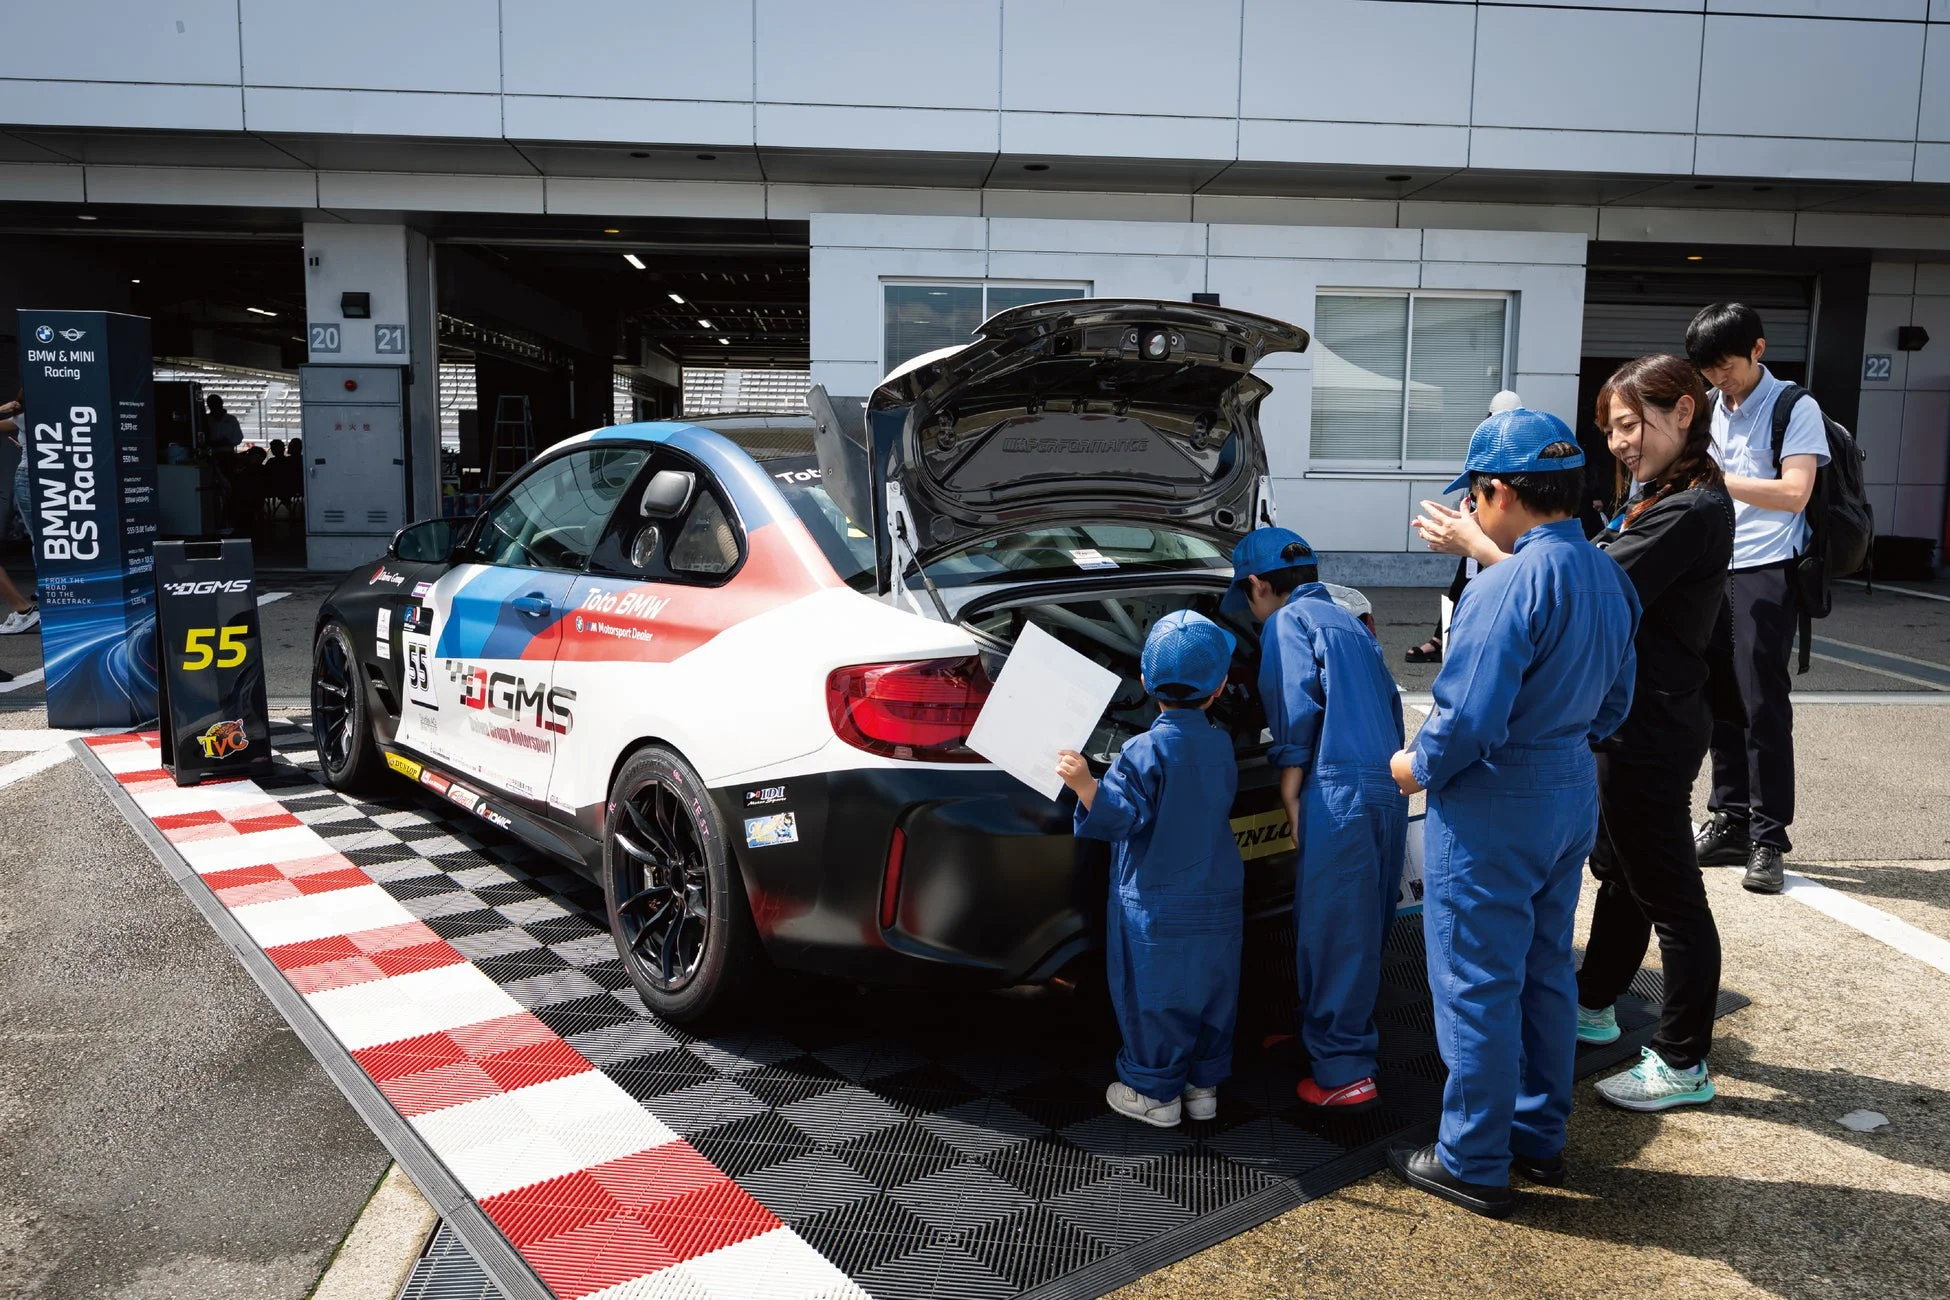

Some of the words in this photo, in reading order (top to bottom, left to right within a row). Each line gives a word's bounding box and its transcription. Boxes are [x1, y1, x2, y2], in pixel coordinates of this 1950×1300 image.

[311, 327, 339, 349] 20
[377, 328, 402, 350] 21
[28, 350, 56, 362] BMW
[58, 350, 68, 362] &
[70, 350, 95, 362] MINI
[1866, 357, 1890, 378] 22
[44, 365, 81, 381] Racing
[34, 422, 65, 469] M2
[1028, 438, 1149, 454] PERFORMANCE
[65, 406, 97, 511] Racing
[38, 477, 71, 560] BMW
[70, 520, 100, 561] CS
[171, 579, 252, 596] DGMS
[581, 587, 618, 614] Toto
[614, 592, 672, 619] BMW
[598, 621, 632, 639] Motorsport
[631, 627, 654, 642] Dealer
[182, 625, 249, 671] 55
[407, 641, 430, 692] 55
[460, 666, 577, 735] DGMS
[197, 730, 249, 759] TVC
[509, 727, 552, 755] Motorsport
[395, 760, 418, 776] DUNLOP
[760, 786, 785, 801] IDI
